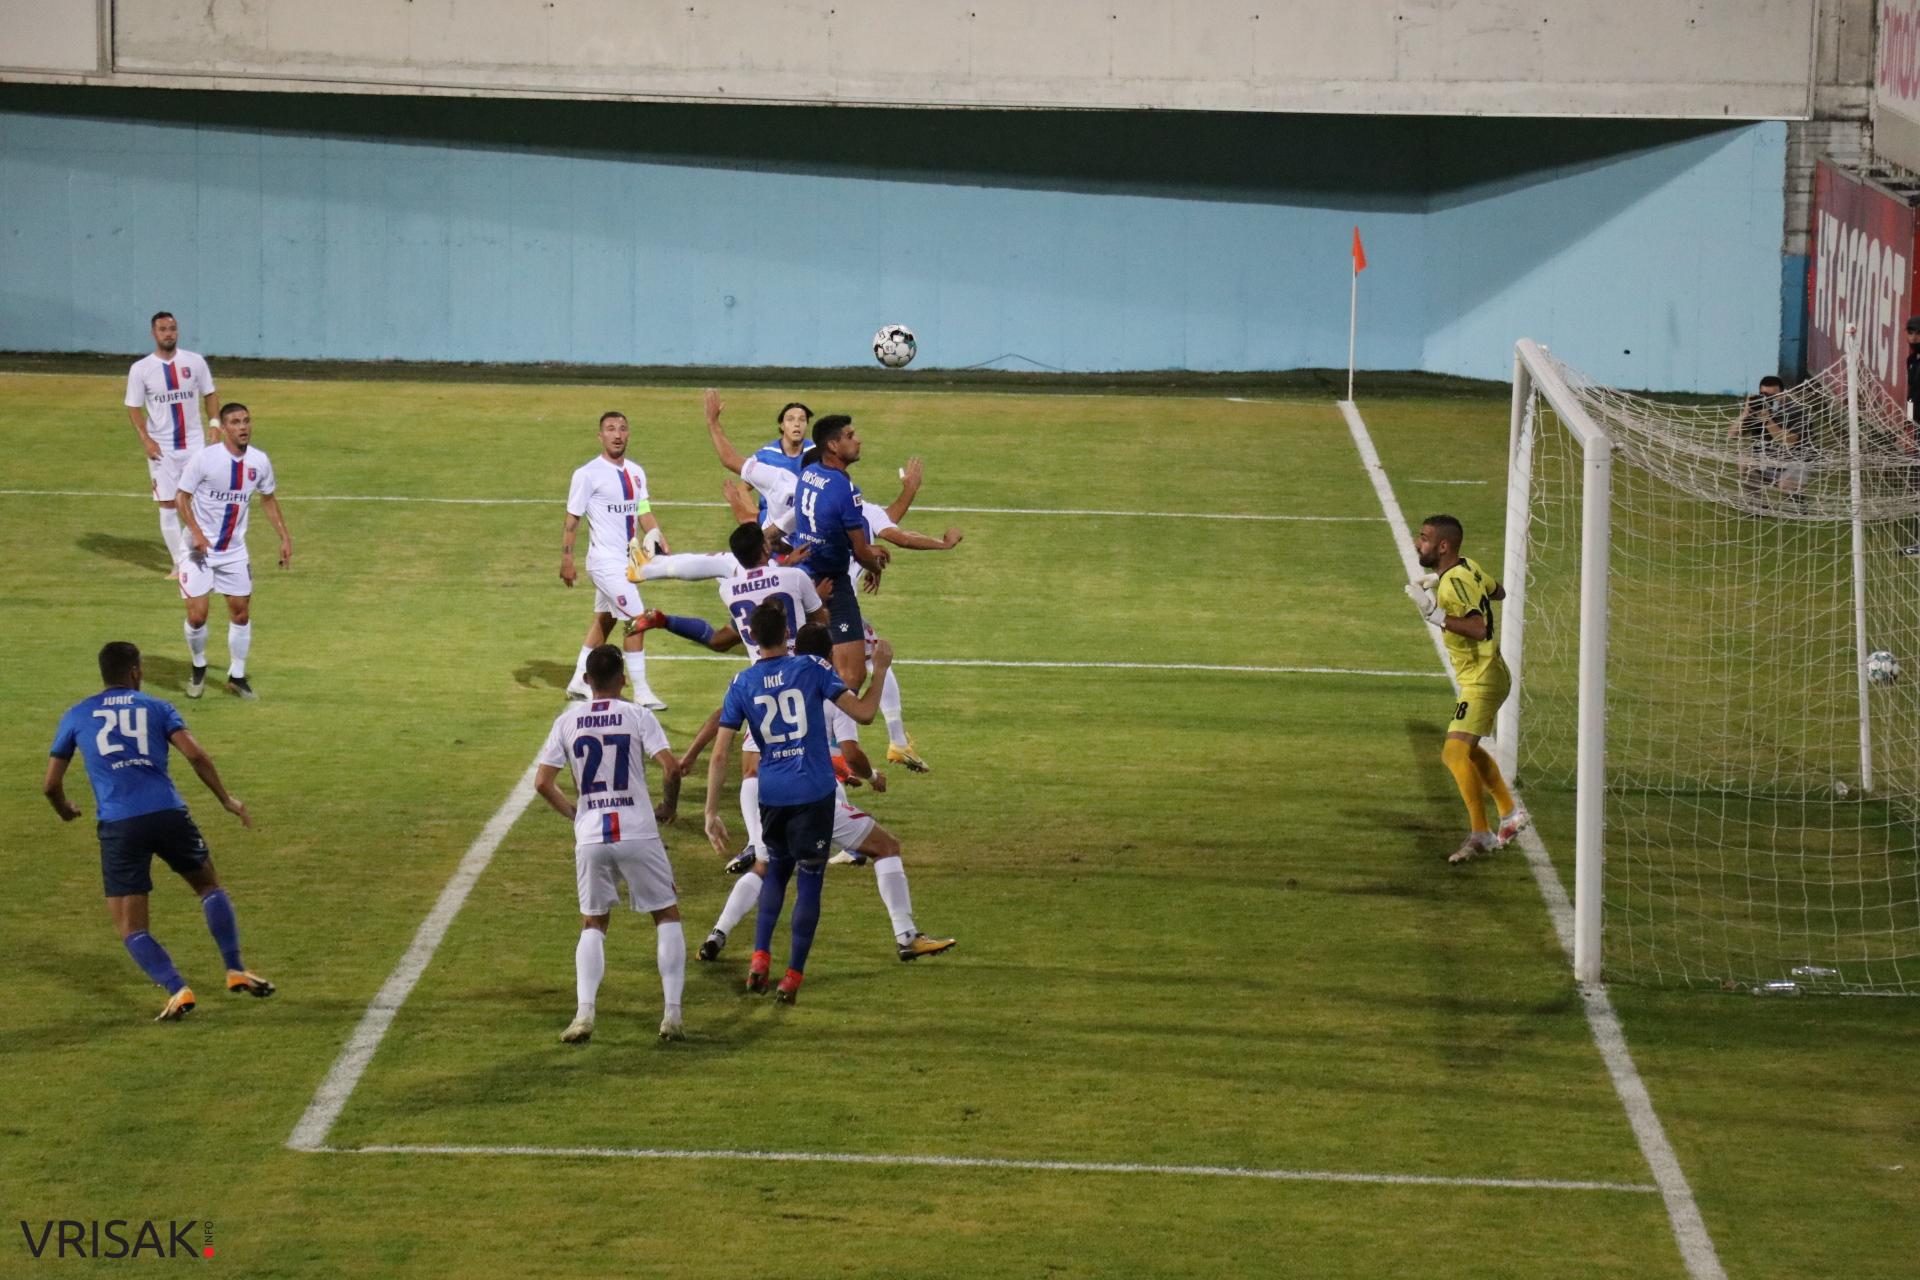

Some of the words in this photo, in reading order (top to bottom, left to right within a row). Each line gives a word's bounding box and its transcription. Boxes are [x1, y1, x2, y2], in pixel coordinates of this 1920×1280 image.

[209, 490, 249, 502] FUJIFIL
[801, 487, 818, 533] 4
[732, 574, 780, 596] KALEZIĆ
[763, 670, 785, 689] IKIĆ
[92, 707, 149, 757] 24
[576, 714, 623, 730] HOXHAJ
[753, 688, 808, 745] 29
[573, 733, 631, 796] 27
